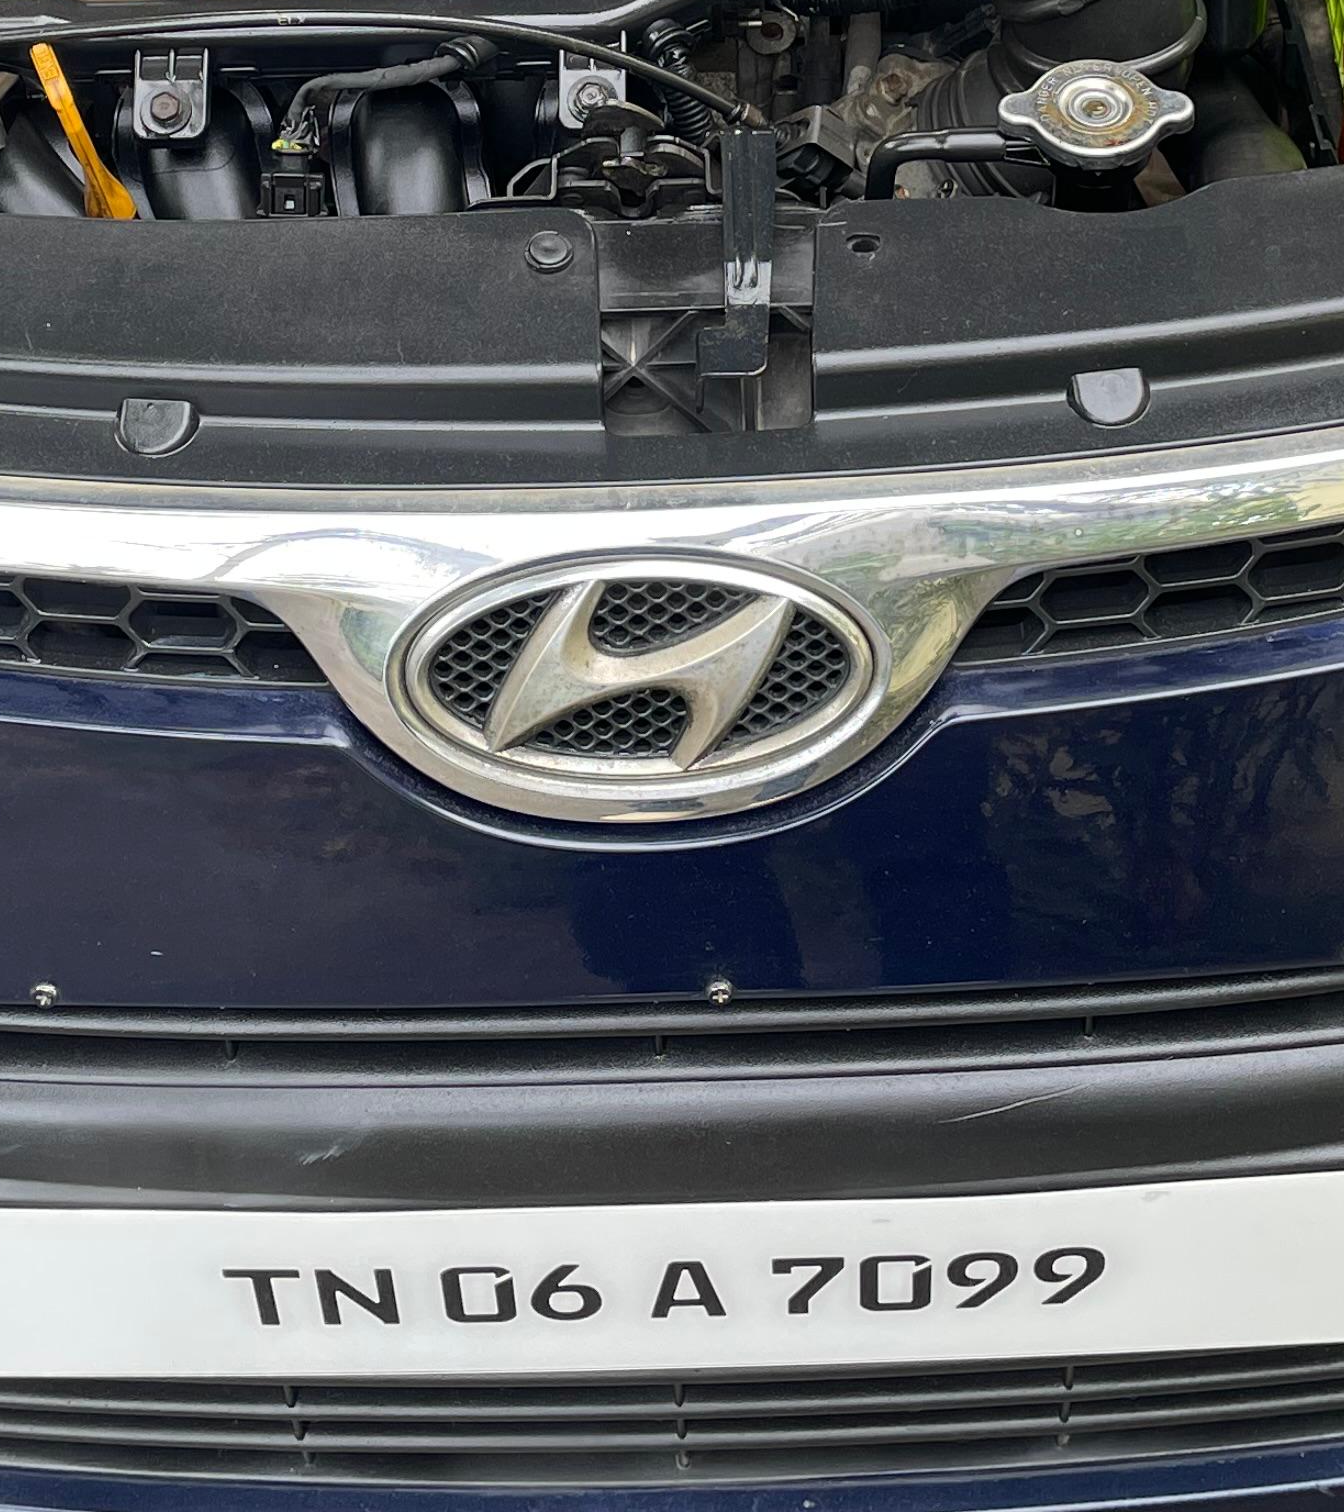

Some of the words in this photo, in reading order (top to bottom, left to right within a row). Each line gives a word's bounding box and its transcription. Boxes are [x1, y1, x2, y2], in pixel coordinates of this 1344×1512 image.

[1121, 70, 1153, 96] OPEN
[224, 1269, 399, 1324] TN
[441, 1265, 601, 1322] 06
[652, 1262, 726, 1317] A
[773, 1248, 1105, 1313] 7099
